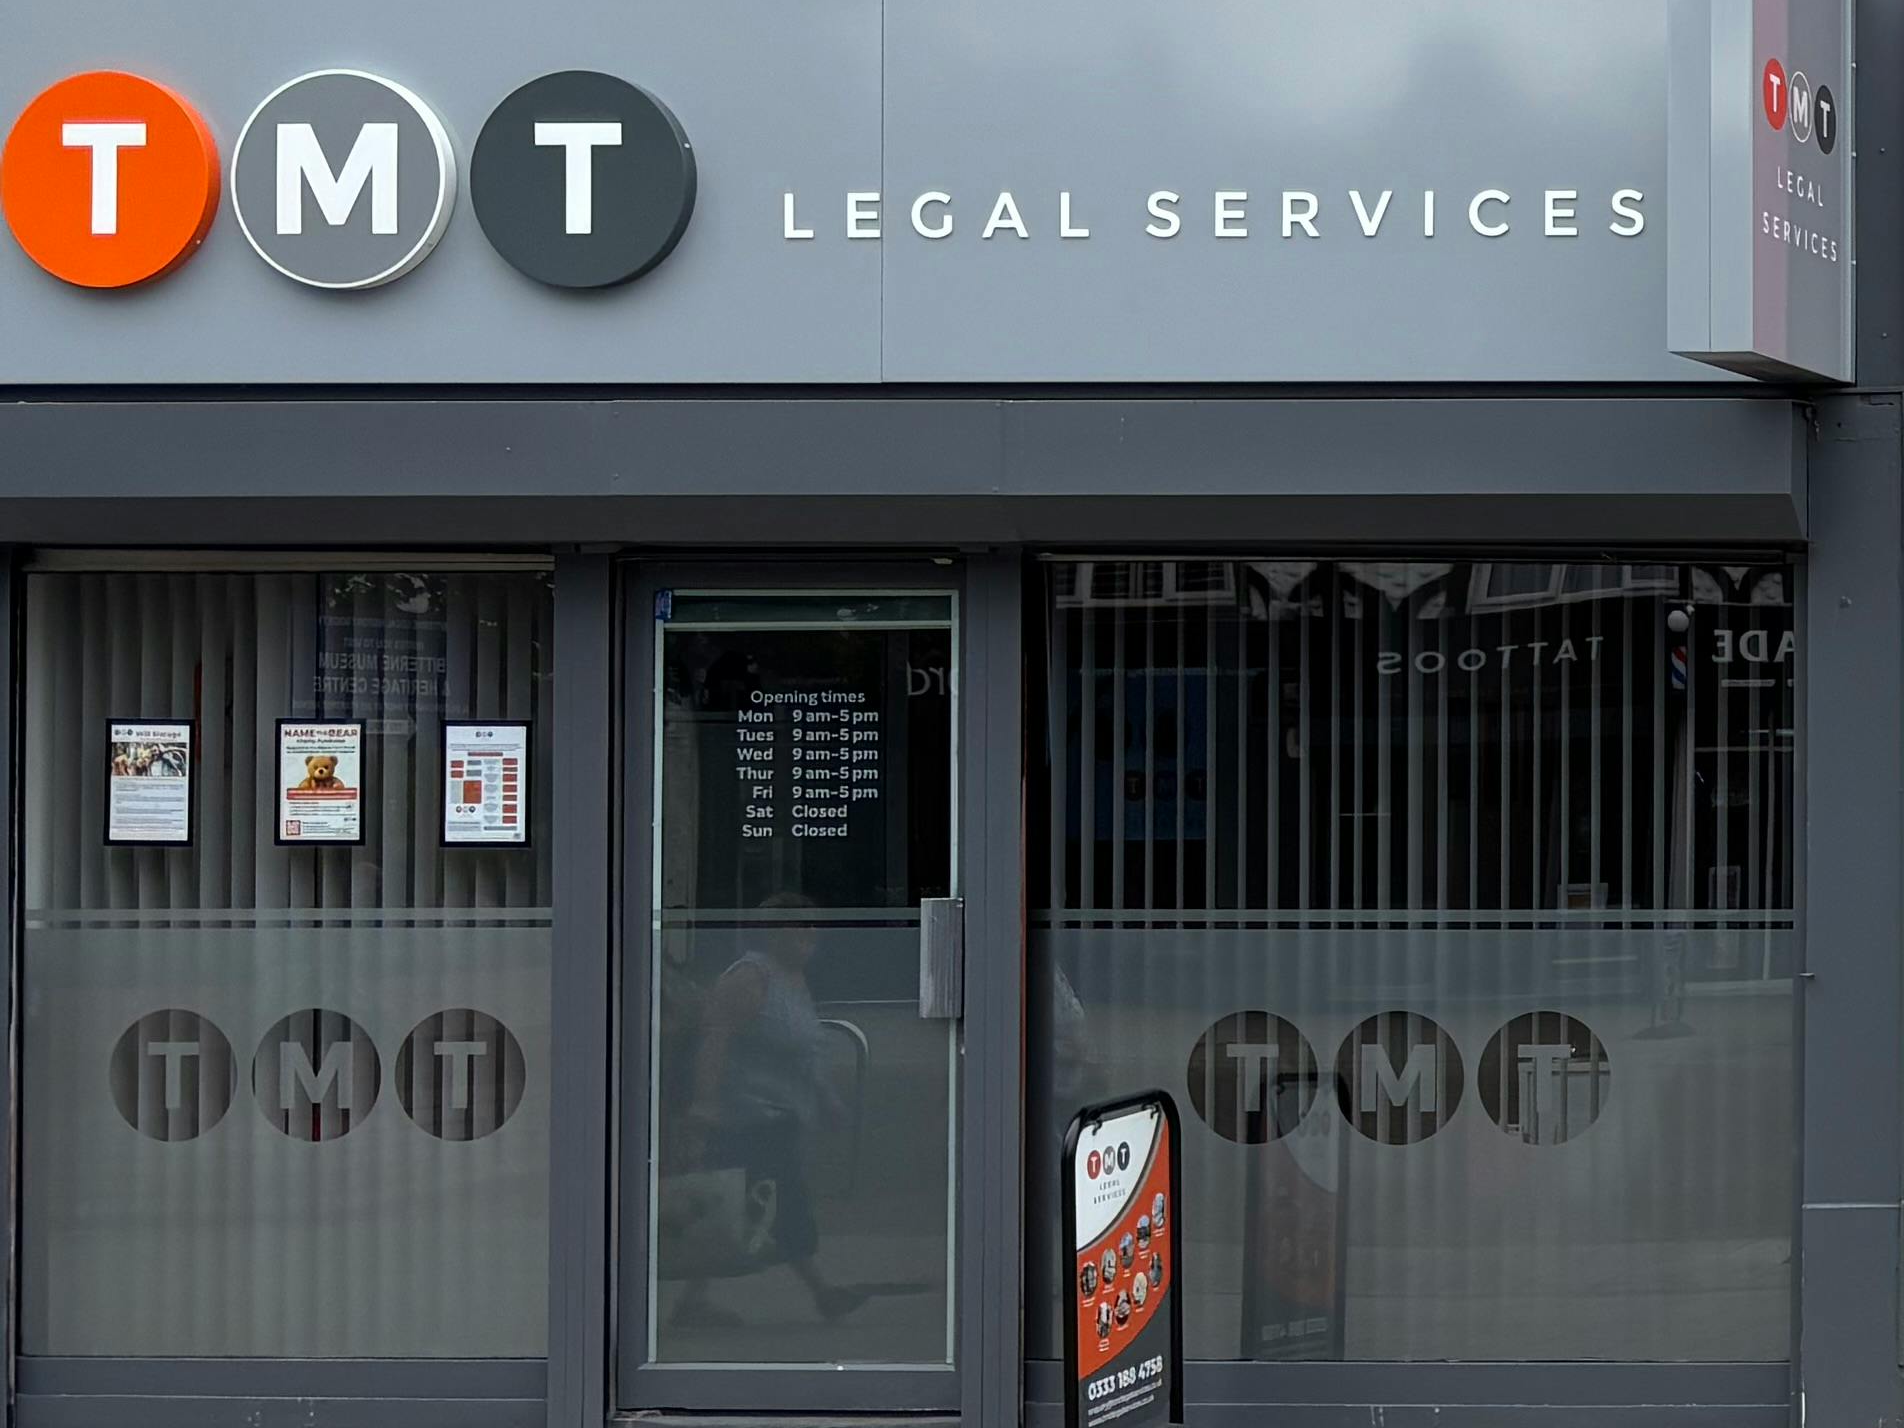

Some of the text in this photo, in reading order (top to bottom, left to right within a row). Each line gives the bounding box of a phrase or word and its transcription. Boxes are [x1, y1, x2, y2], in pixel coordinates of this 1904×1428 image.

[1777, 165, 1825, 208] LEGAL
[783, 192, 1089, 239] LEGAL
[1146, 190, 1645, 238] SERVICES
[1763, 211, 1838, 262] SERVICES
[750, 690, 866, 706] Opening times
[738, 709, 774, 723] Mon
[284, 729, 358, 738] NAME BEAR
[737, 728, 774, 742] Tues
[737, 748, 774, 761] Wed
[736, 767, 774, 780] Thur
[753, 786, 773, 800] Fri
[746, 804, 848, 819] Sat Closed
[742, 824, 848, 838] Sun Closed
[1088, 1375, 1116, 1401] 0333
